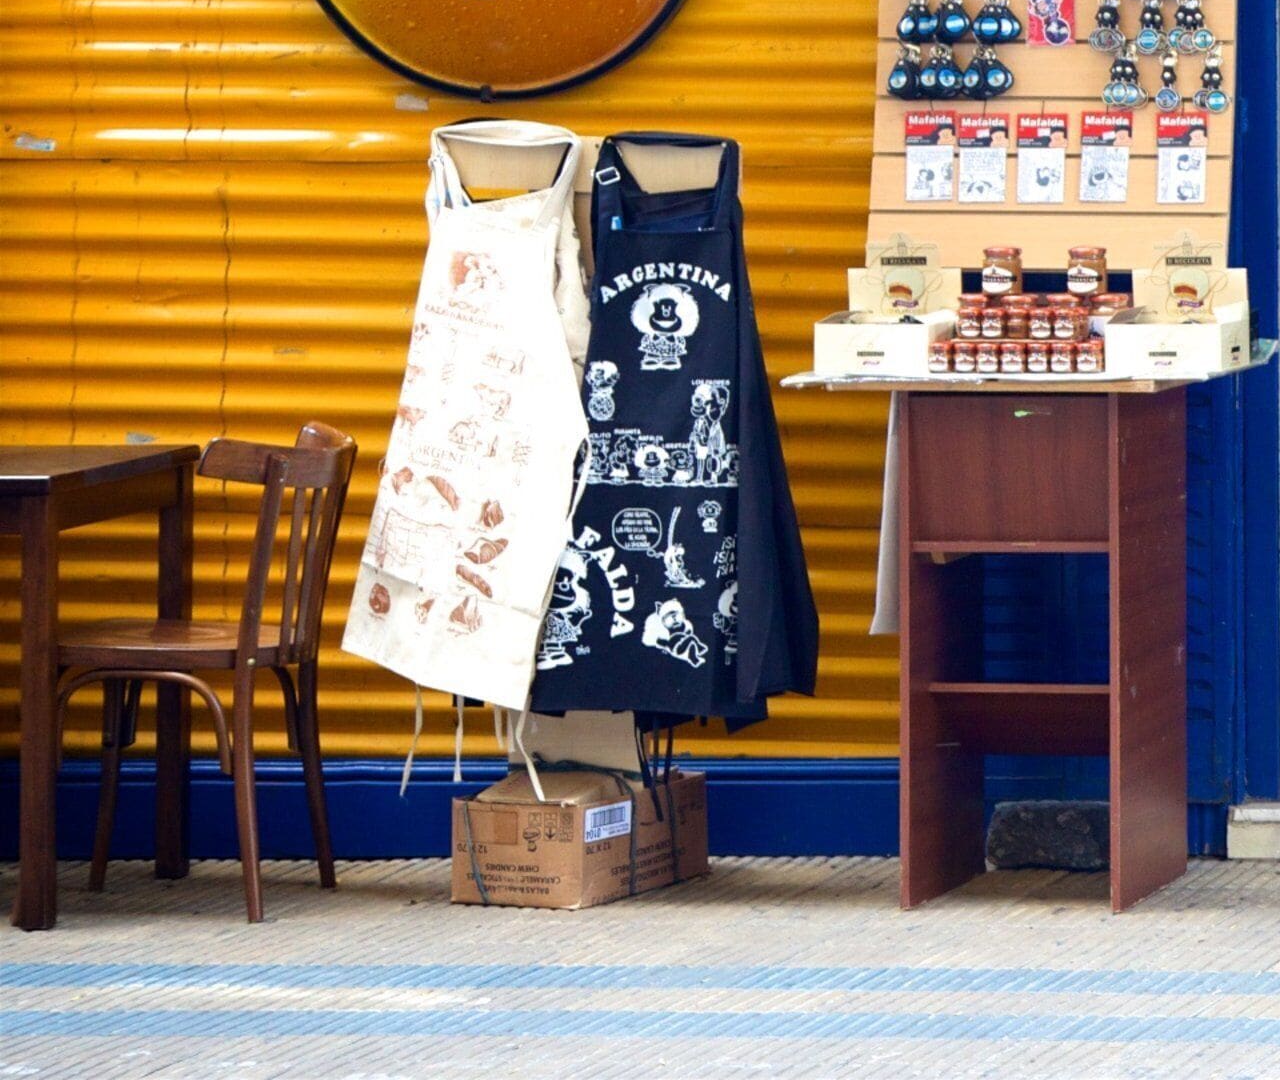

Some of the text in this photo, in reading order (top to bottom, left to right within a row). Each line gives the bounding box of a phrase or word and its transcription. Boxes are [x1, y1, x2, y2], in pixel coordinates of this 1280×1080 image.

[908, 115, 952, 126] Mafalda
[961, 117, 1006, 128] Mafalda
[1020, 117, 1065, 128] Mafalda
[1084, 115, 1130, 126] Mafalda
[1159, 116, 1204, 127] Mafalda
[600, 262, 732, 304] ARGENTINA
[574, 525, 636, 639] FALDA
[519, 865, 540, 873] CHEW
